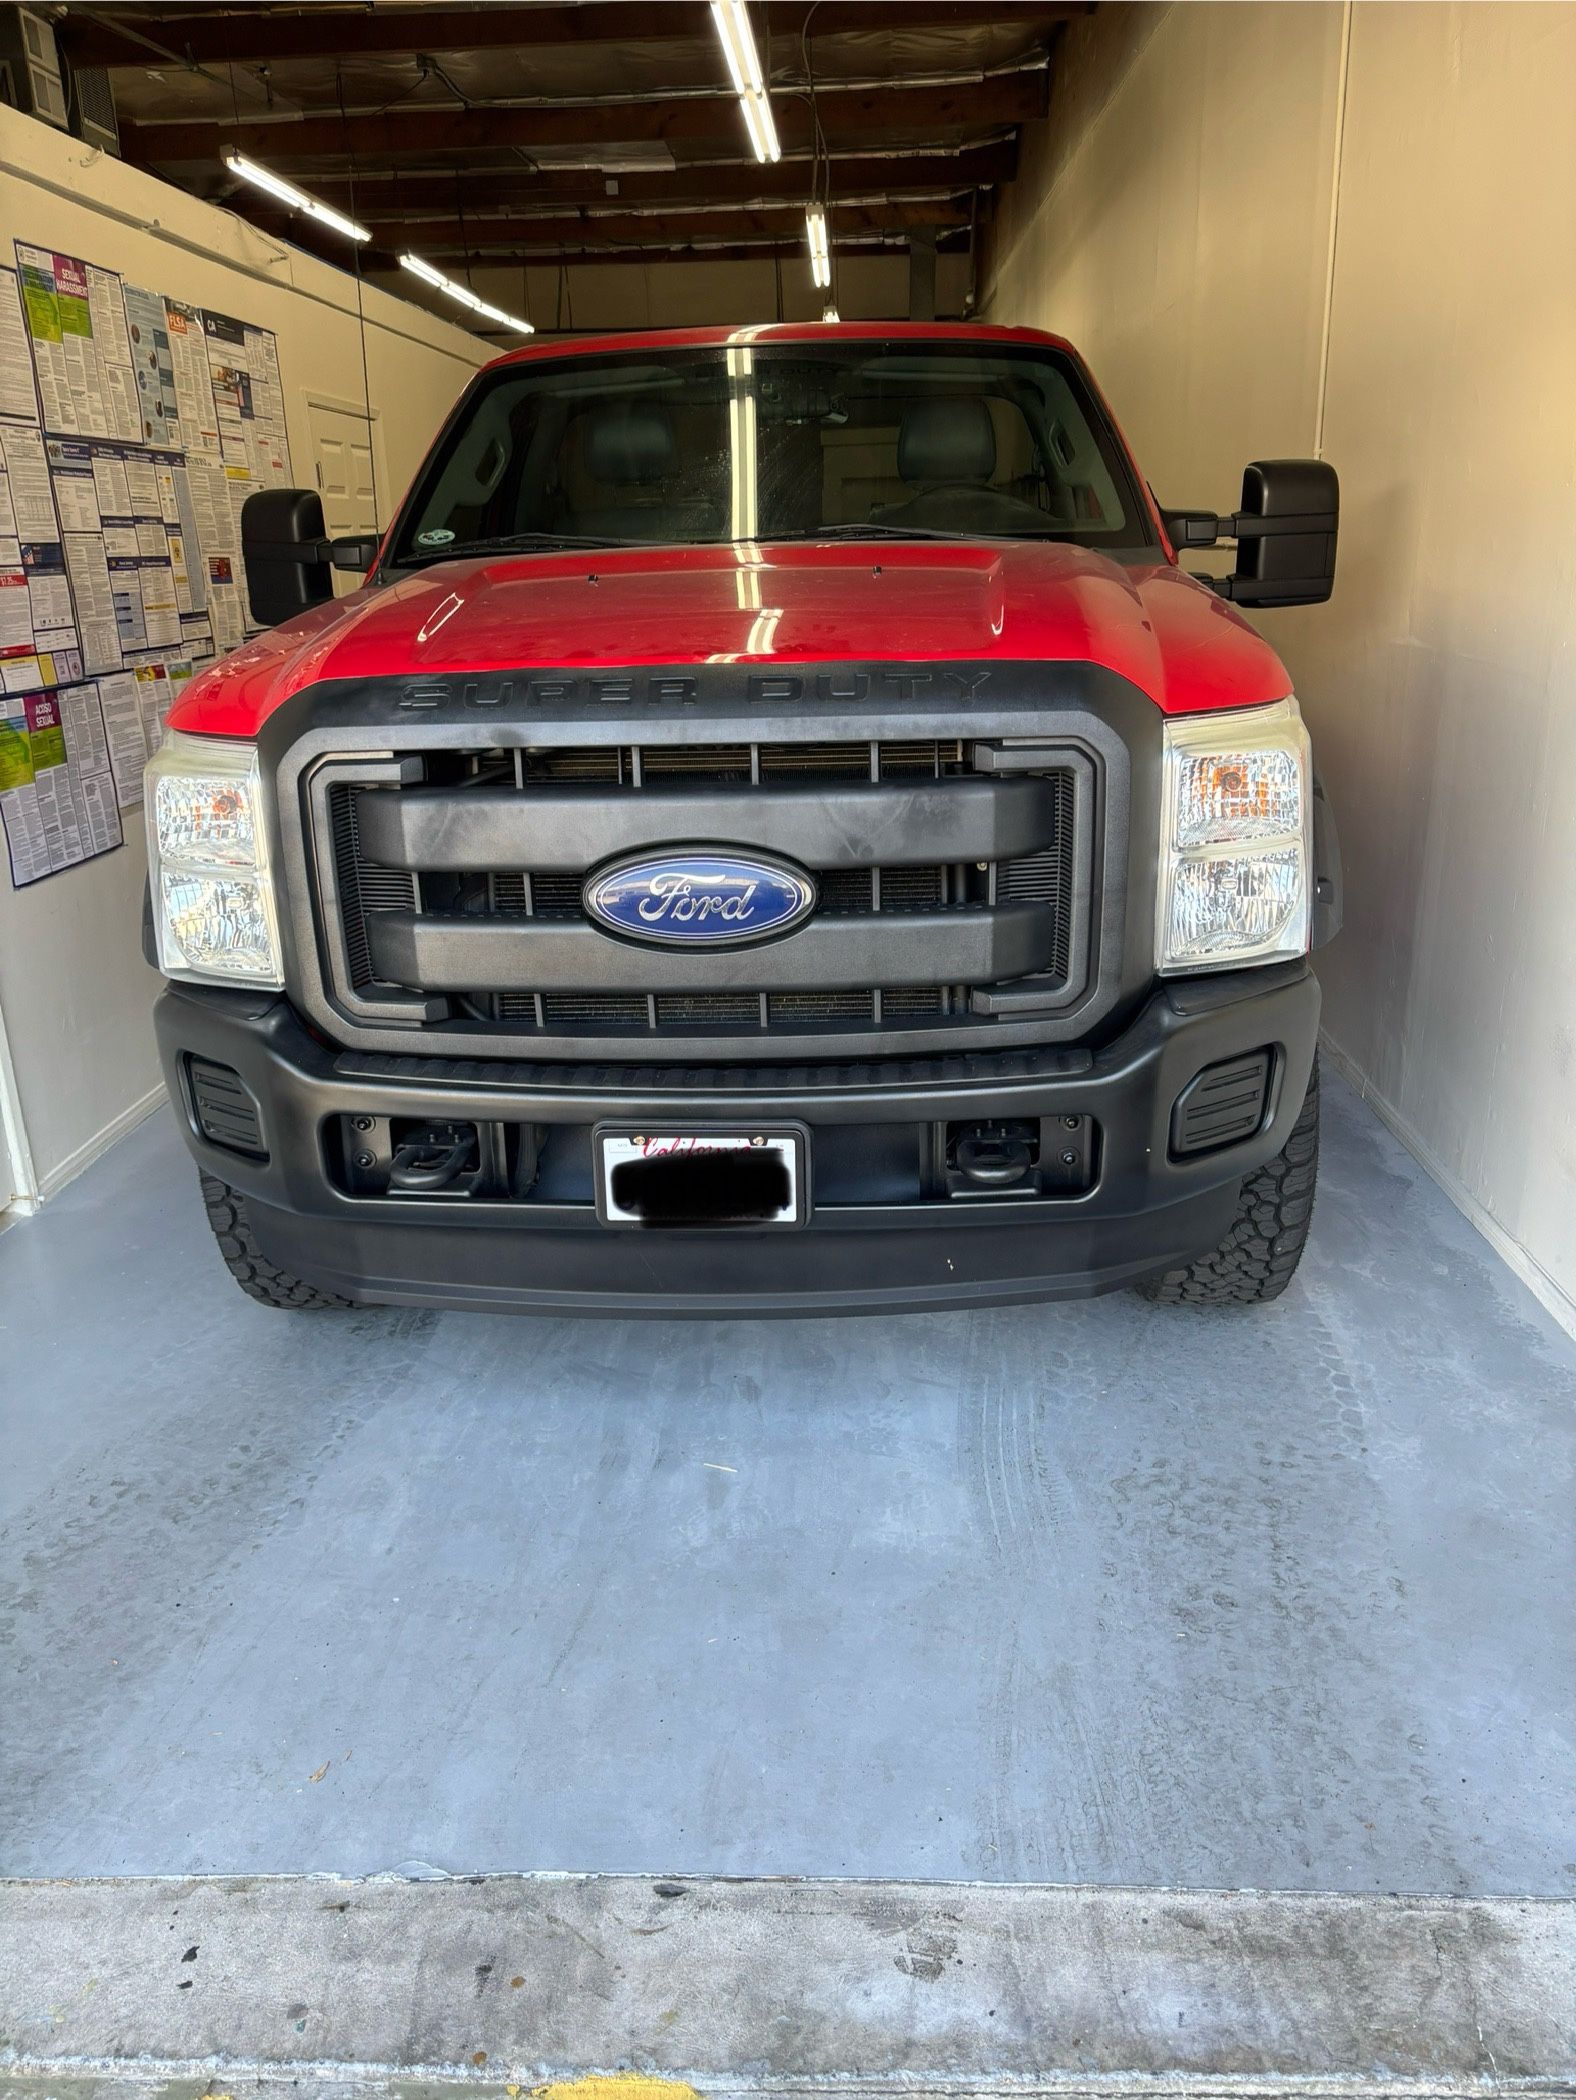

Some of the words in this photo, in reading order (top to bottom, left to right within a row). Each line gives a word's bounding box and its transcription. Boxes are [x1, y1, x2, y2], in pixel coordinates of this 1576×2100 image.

[169, 314, 186, 330] FLSA
[397, 676, 698, 711] SUPER
[747, 671, 992, 704] DUTY
[35, 702, 52, 716] ACOSO
[36, 714, 56, 728] SEXUAL
[638, 872, 756, 922] Ford
